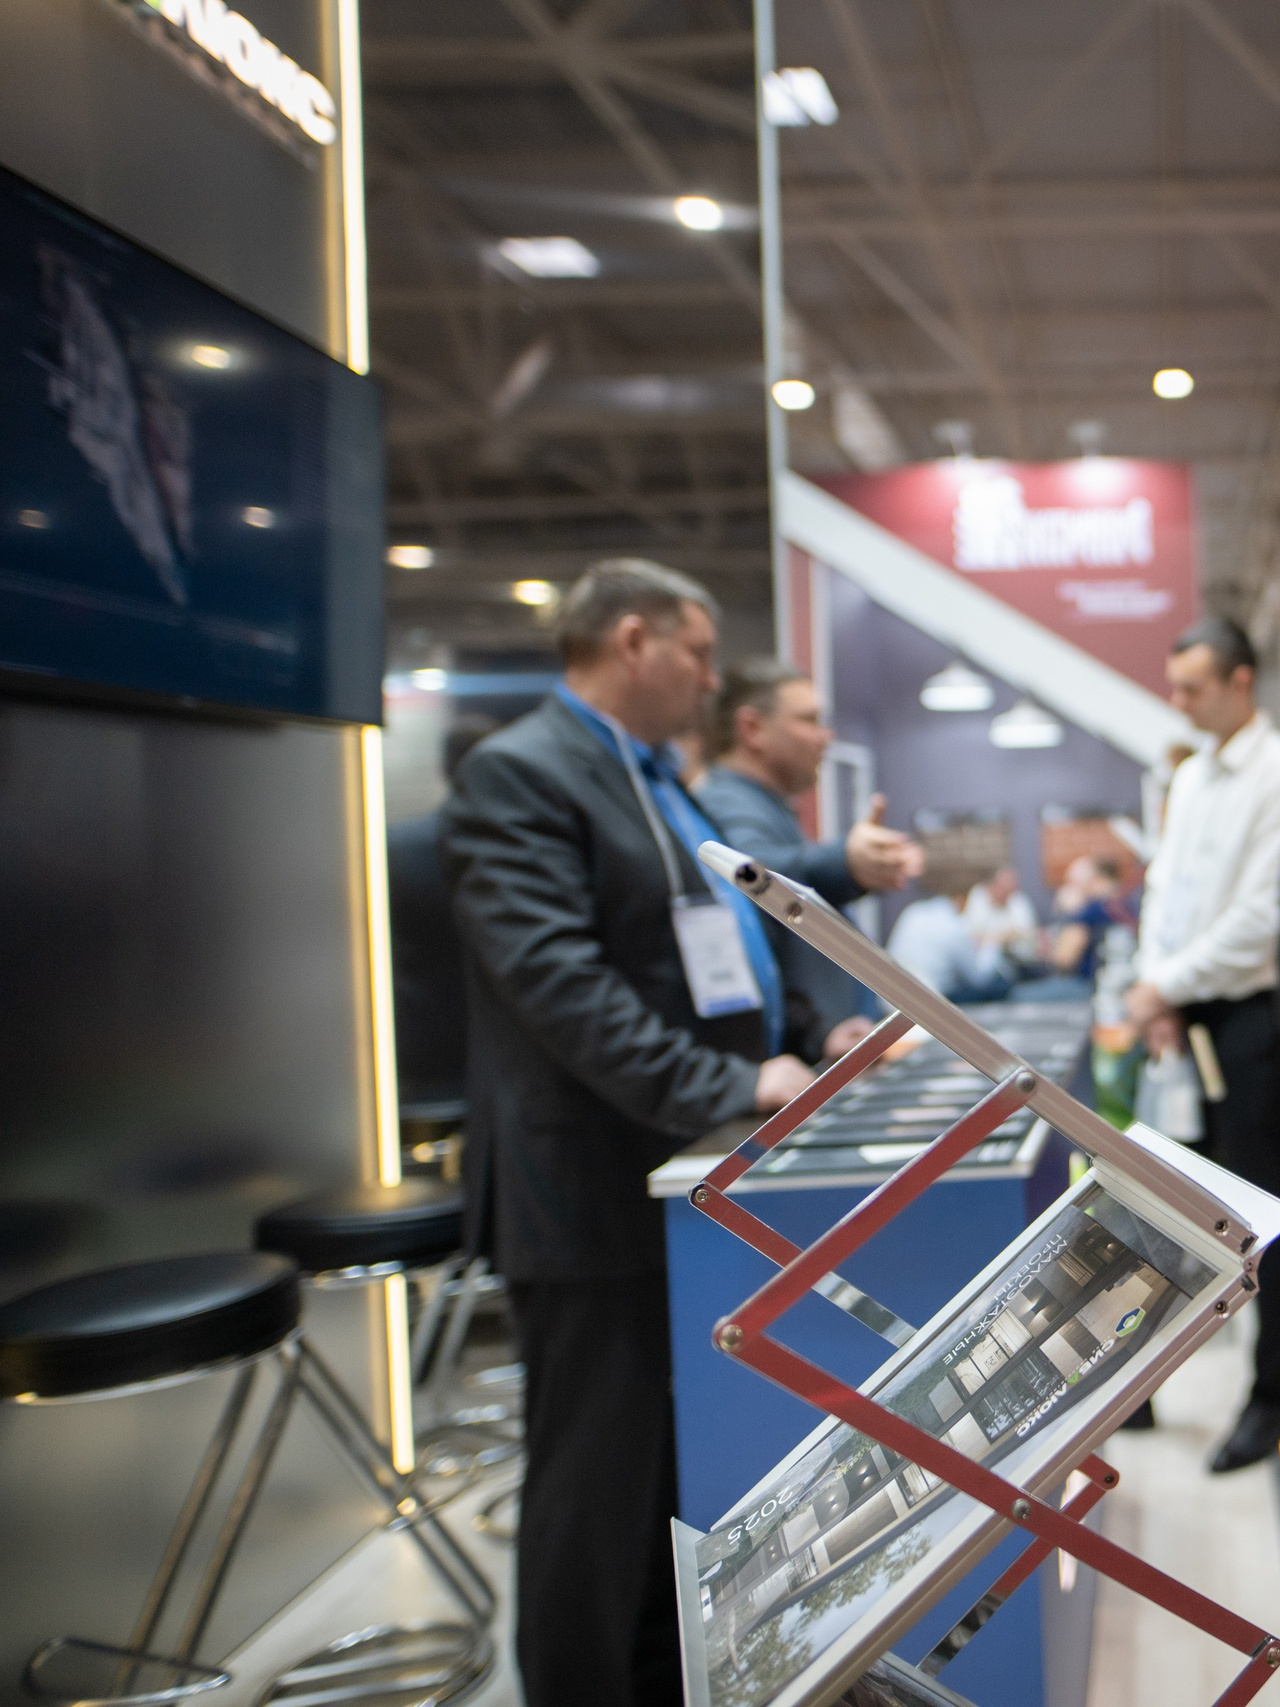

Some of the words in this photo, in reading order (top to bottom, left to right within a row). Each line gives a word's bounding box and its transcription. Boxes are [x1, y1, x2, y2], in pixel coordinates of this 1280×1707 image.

[942, 1239, 1068, 1366] МАЛОЭТАЖНЫЕ
[993, 1233, 1062, 1301] ПРОЕКТЫ
[1016, 1338, 1115, 1438] СИБАЛЮКС
[727, 1485, 793, 1546] 2025
